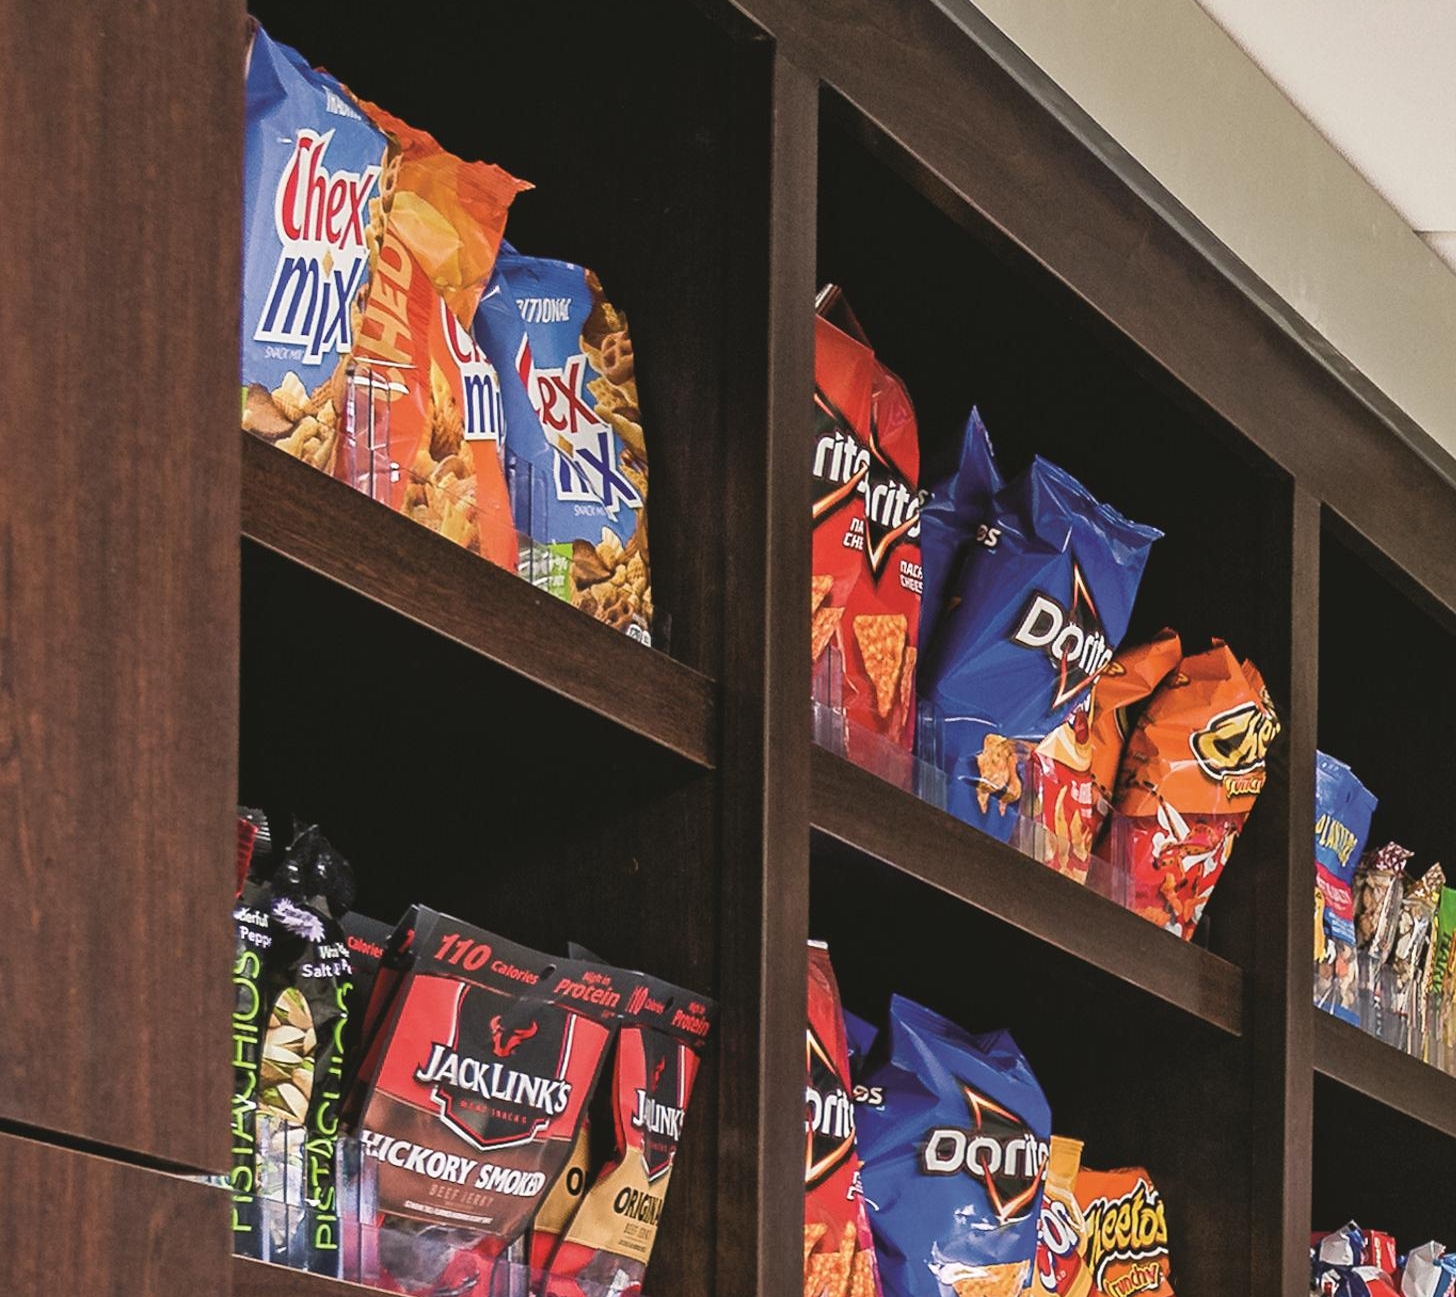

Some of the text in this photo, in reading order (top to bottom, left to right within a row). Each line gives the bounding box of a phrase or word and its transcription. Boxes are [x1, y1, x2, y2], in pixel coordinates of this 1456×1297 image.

[282, 131, 379, 247] Chex
[261, 253, 364, 354] mix
[433, 934, 539, 988] 110 Calories
[554, 979, 623, 1008] Protein
[361, 1130, 477, 1186] HICKORY
